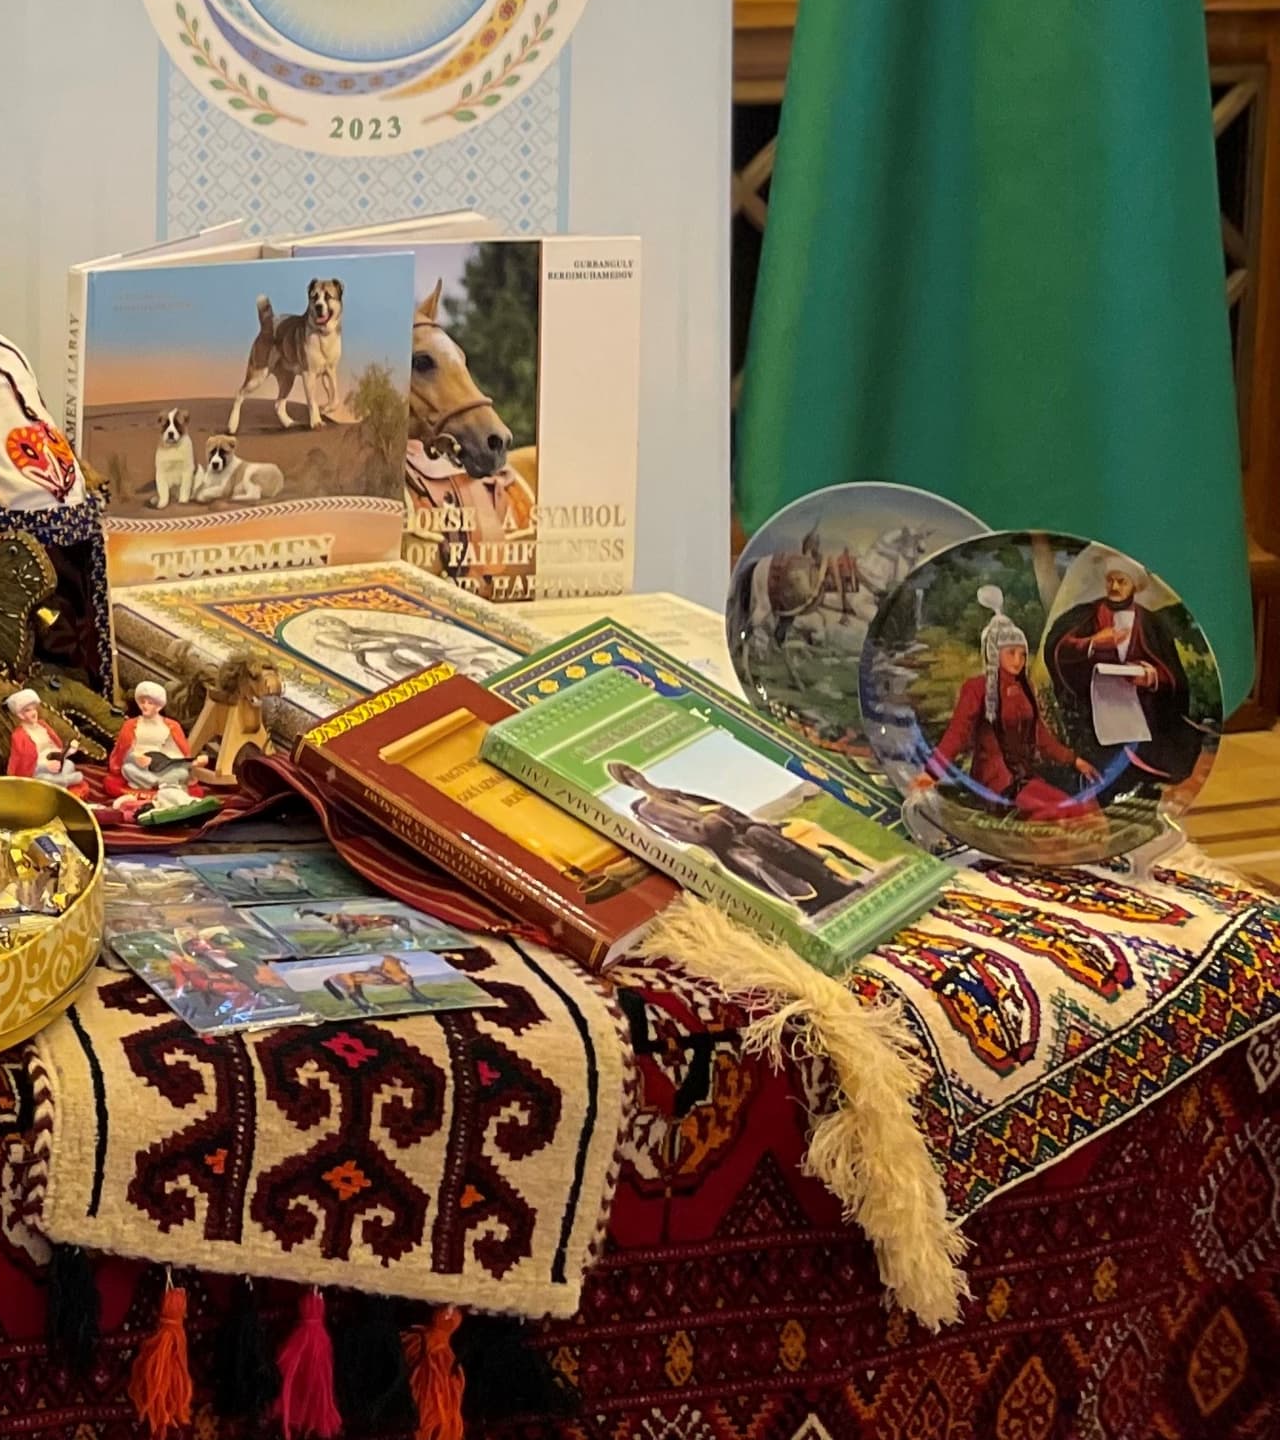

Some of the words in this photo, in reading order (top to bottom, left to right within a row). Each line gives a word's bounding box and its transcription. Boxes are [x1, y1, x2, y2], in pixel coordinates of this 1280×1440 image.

[330, 116, 401, 140] 2023
[529, 504, 626, 530] SYMBOL
[406, 542, 439, 567] OF
